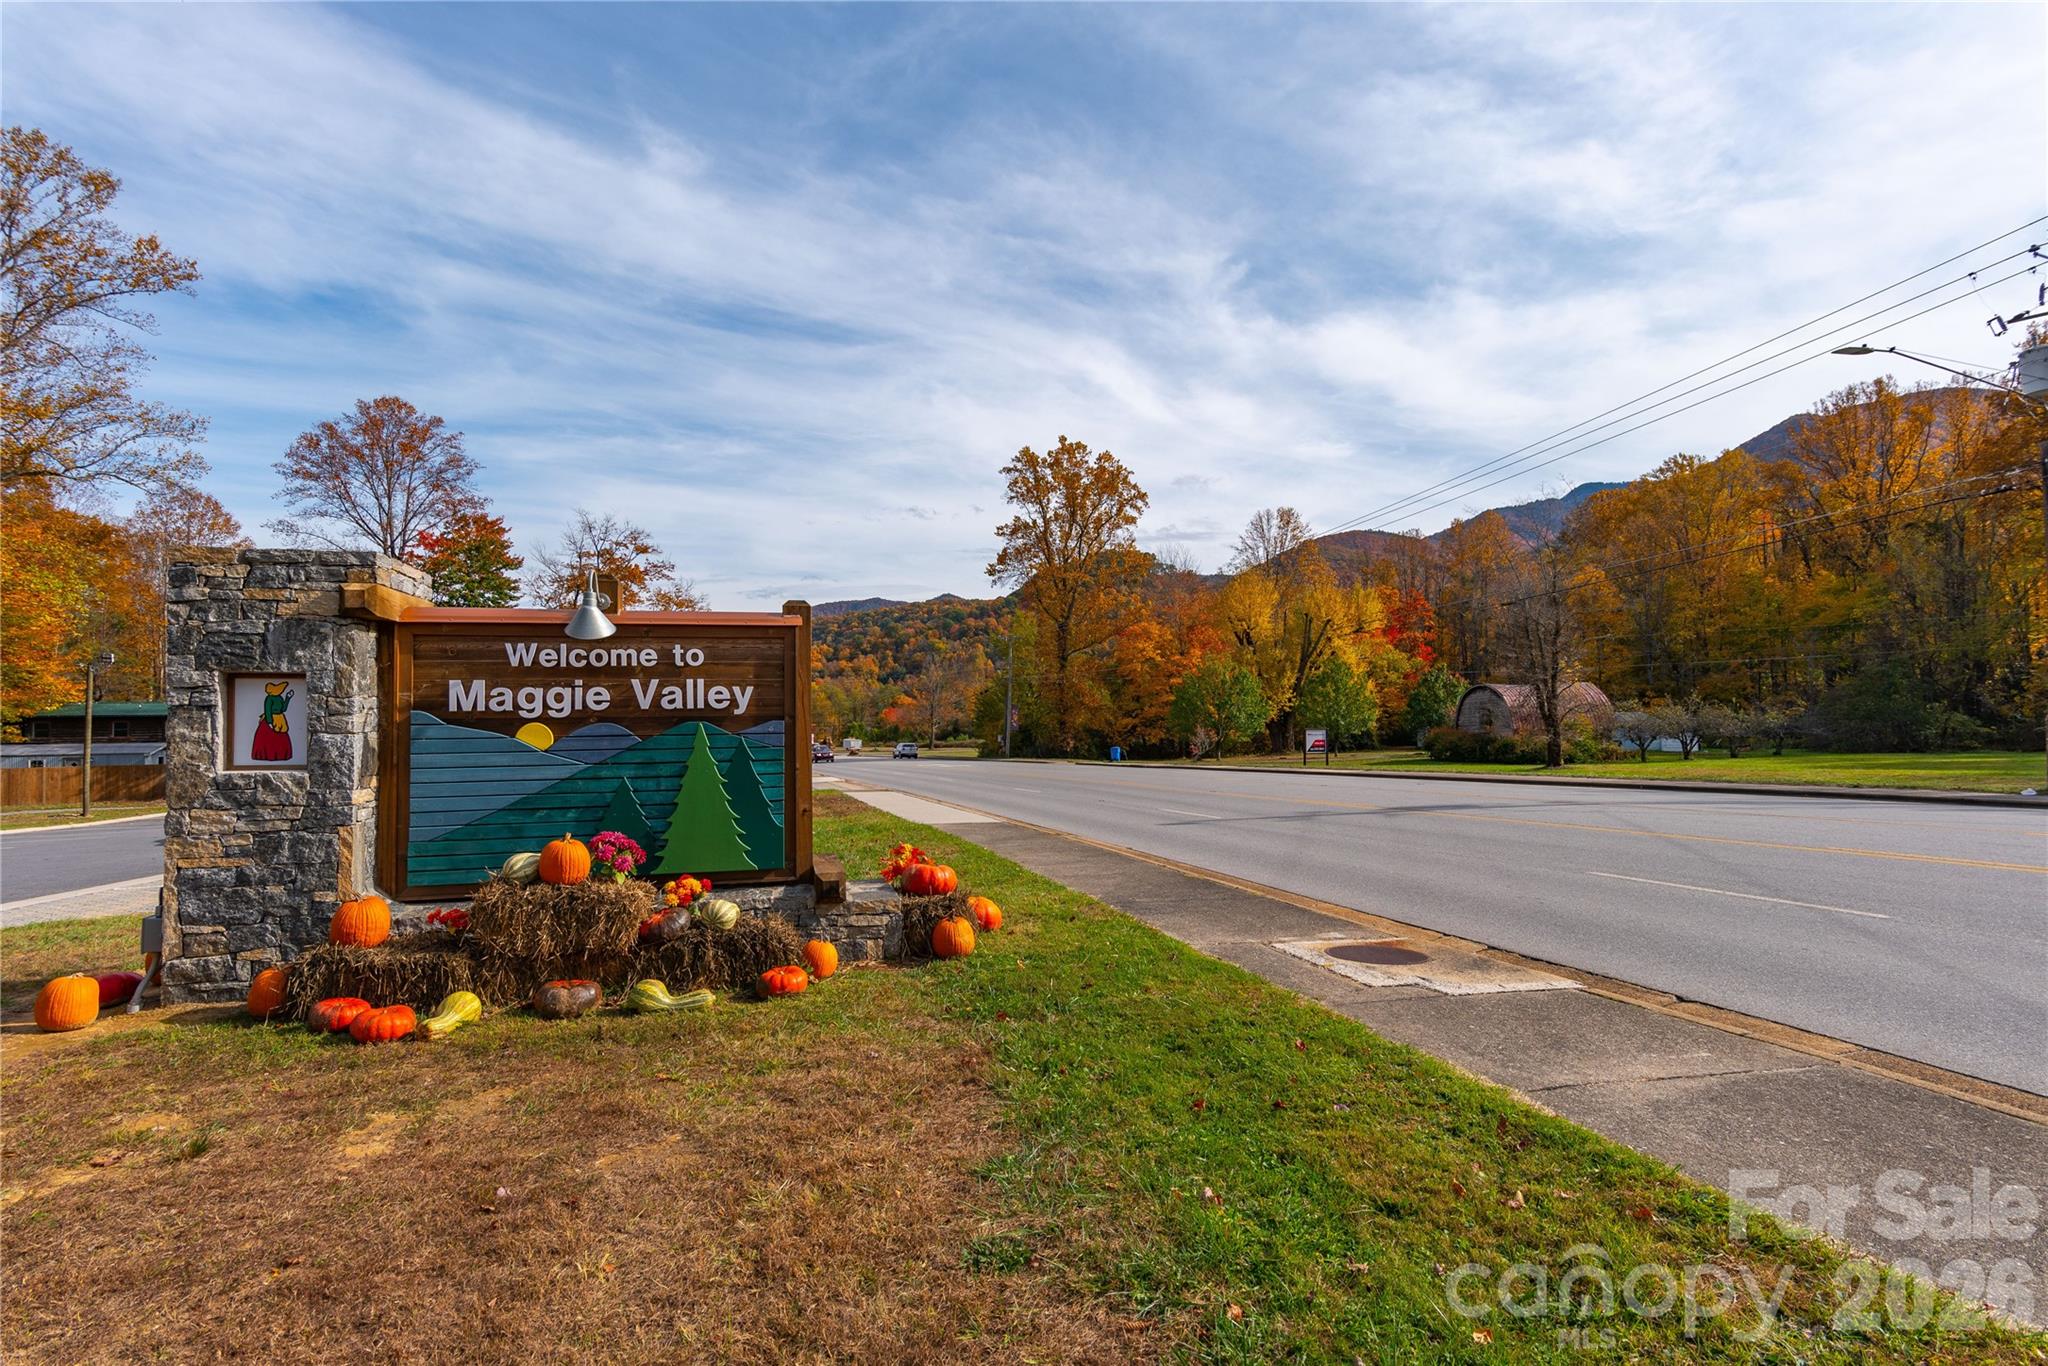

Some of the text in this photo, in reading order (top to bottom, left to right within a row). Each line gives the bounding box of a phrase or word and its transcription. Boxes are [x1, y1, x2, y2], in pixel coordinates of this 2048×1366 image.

[504, 642, 705, 668] Welcome to
[448, 677, 754, 718] Maggie Valley
